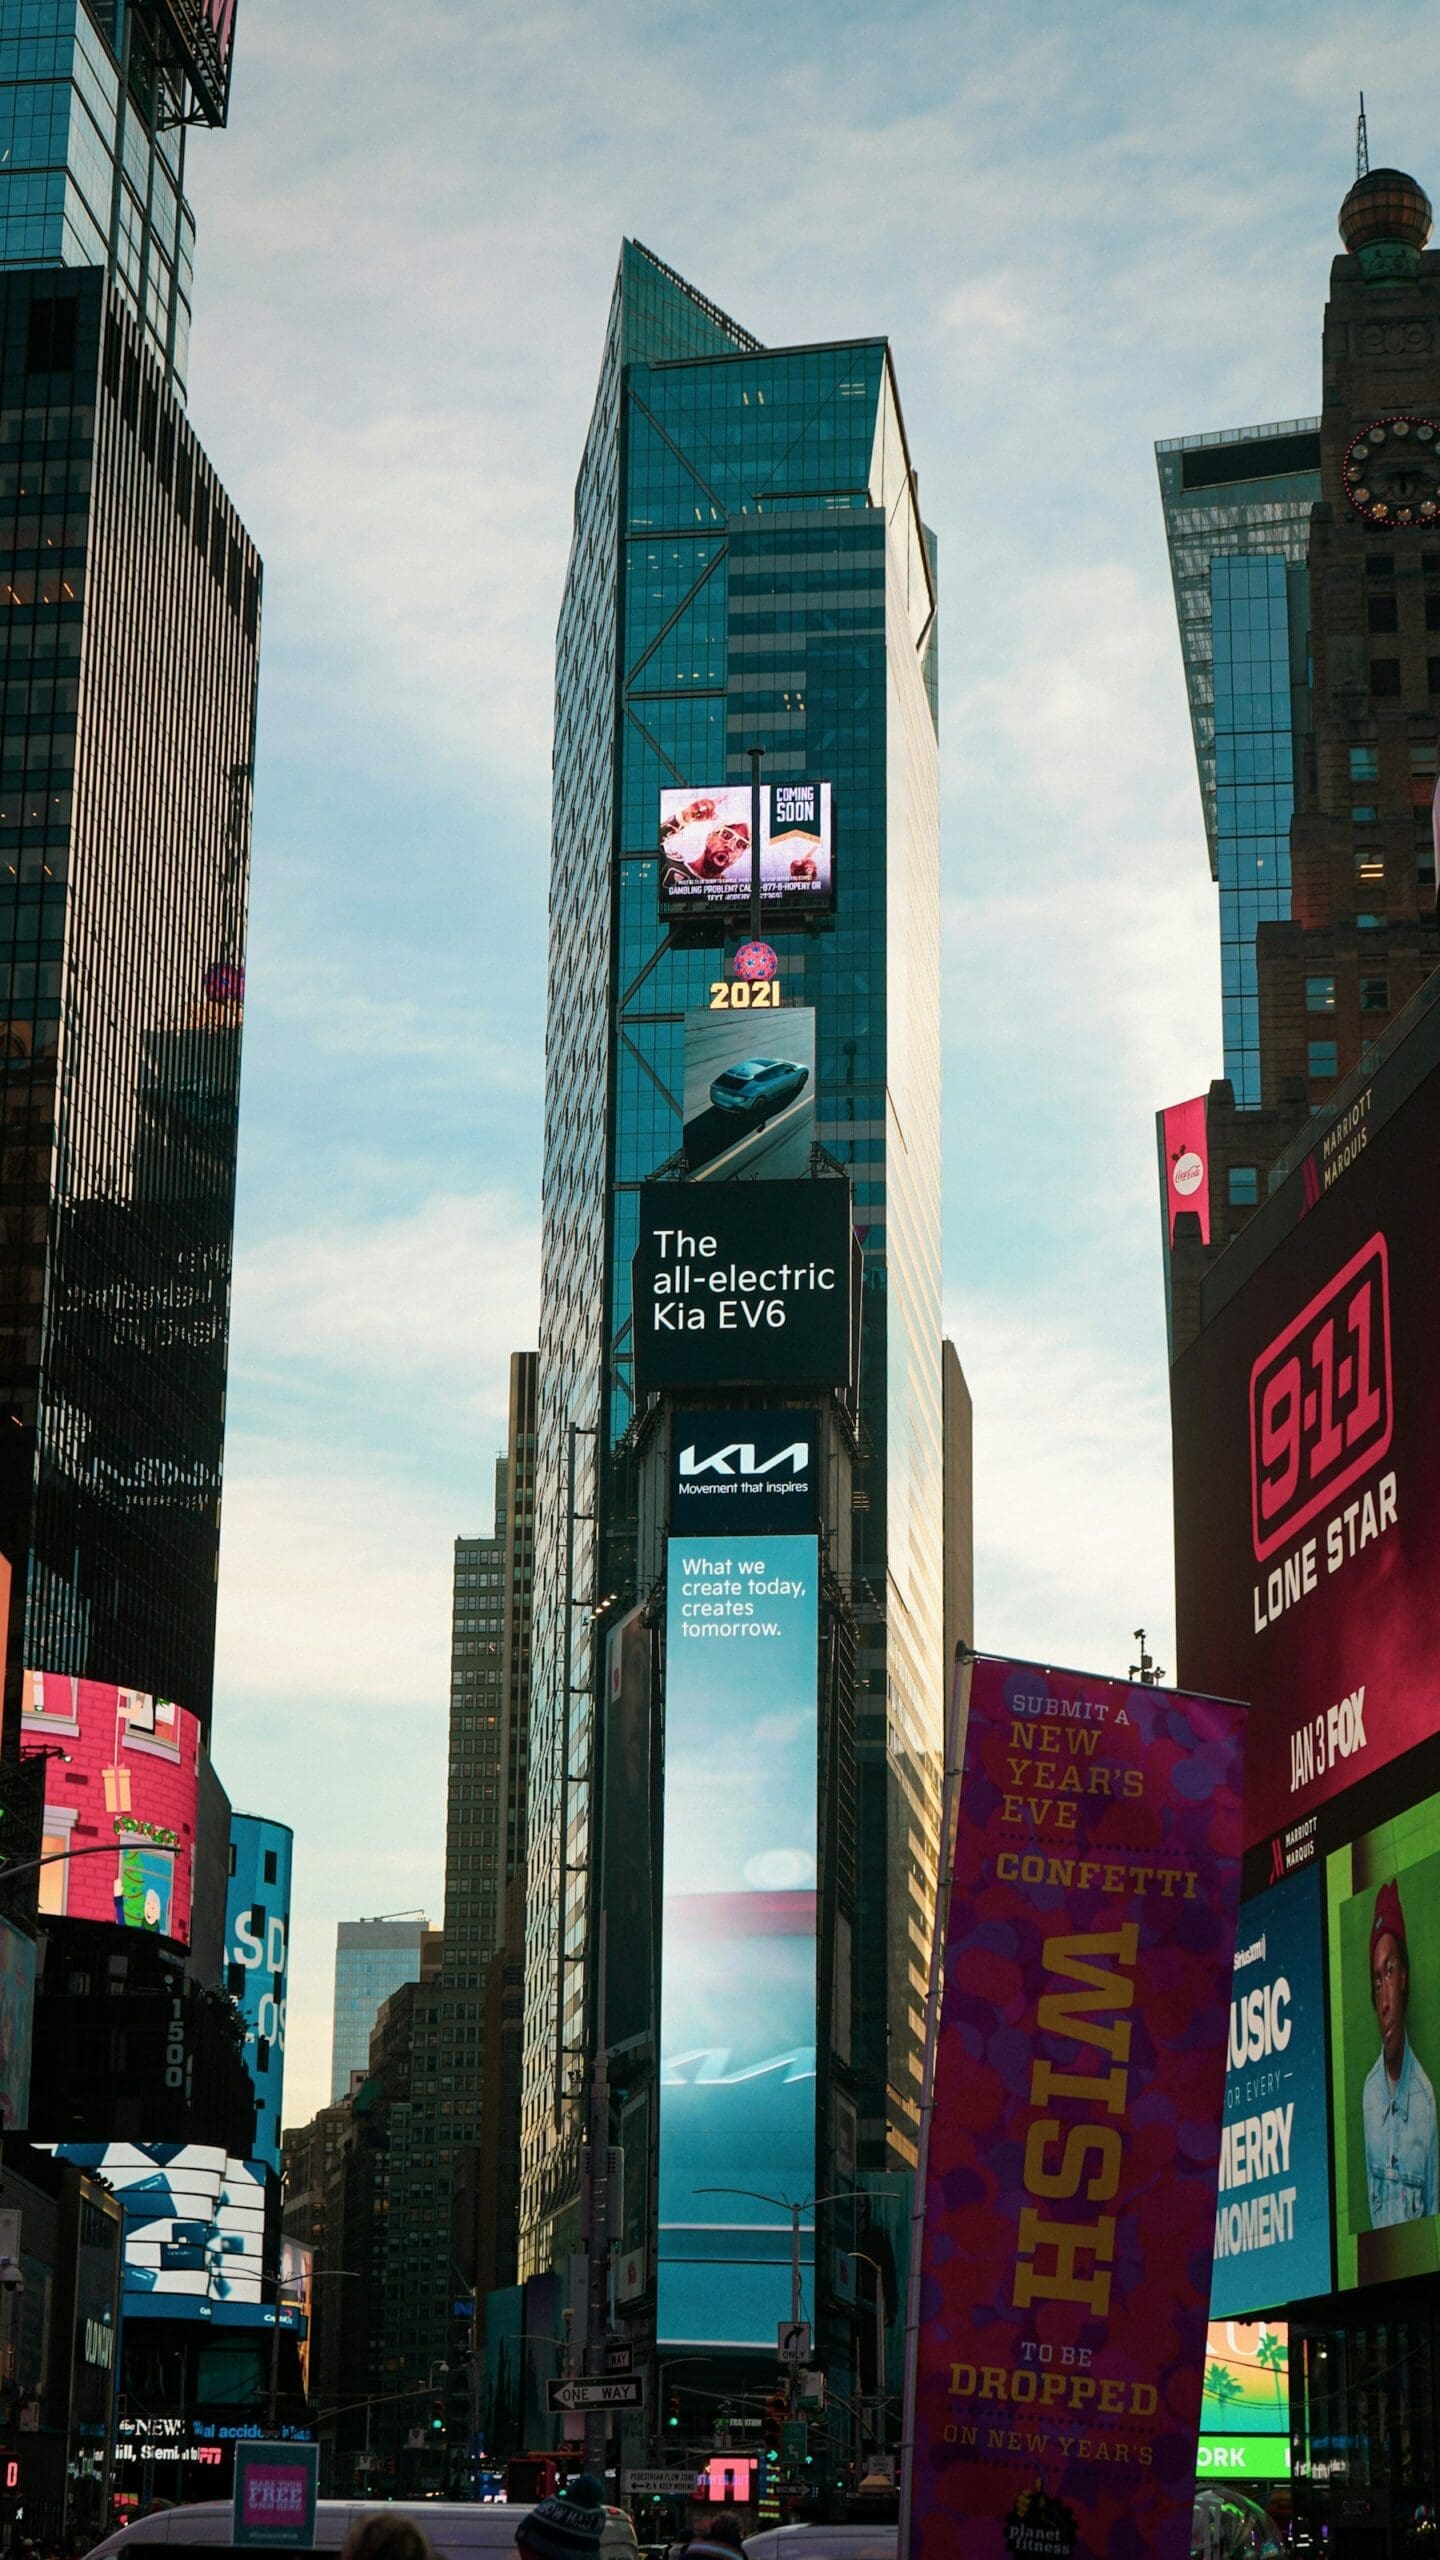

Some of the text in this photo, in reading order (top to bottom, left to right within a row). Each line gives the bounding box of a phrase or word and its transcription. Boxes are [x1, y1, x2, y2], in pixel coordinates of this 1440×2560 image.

[777, 787, 814, 802] COMING
[777, 802, 814, 823] SOON
[669, 885, 702, 896] GAMBLING
[704, 883, 739, 894] PROBLEM?
[740, 883, 752, 893] CAL
[710, 981, 781, 1010] 2021
[1323, 1088, 1372, 1161] MARRIOTT
[1324, 1126, 1368, 1190] MARQUIS
[653, 1230, 718, 1258] The
[653, 1263, 835, 1294] all-electric
[653, 1299, 786, 1331] Kia EV6
[679, 1443, 809, 1475] KIA
[678, 1480, 808, 1495] Movement that inspires
[682, 1558, 765, 1576] What we
[1254, 1471, 1399, 1635] LONE STAR
[682, 1576, 807, 1599] create today,
[682, 1600, 754, 1616] creates
[682, 1620, 781, 1637] tomorrow.
[1012, 1694, 1130, 1726] SUBMIT A
[1009, 1721, 1102, 1756] NEW
[1290, 1685, 1368, 1794] JAN 3 FOX
[1007, 1757, 1144, 1798] YEAR'S
[1002, 1793, 1078, 1829] EVE
[1285, 1816, 1318, 1848] MARRIOTT
[1286, 1844, 1315, 1869] MARQUIS
[996, 1852, 1198, 1900] CONFETTI
[164, 1998, 184, 2088] 1500
[1226, 2072, 1281, 2110] OR EVERY
[1012, 1922, 1139, 2317] WISH
[1214, 2187, 1297, 2260] MOMENT
[611, 2354, 626, 2368] WAY
[783, 2351, 805, 2360] ONLY
[1021, 2342, 1093, 2368] TO BE
[563, 2386, 630, 2402] ONE WAY
[948, 2363, 1158, 2417] DROPPED
[943, 2424, 1153, 2466] ON NEW YEAR'S
[1196, 2446, 1246, 2468] ORK
[630, 2472, 663, 2480] PEDESTRIAN
[249, 2488, 302, 2503] FREE
[1008, 2523, 1061, 2546] planet
[1015, 2538, 1070, 2557] fitness
